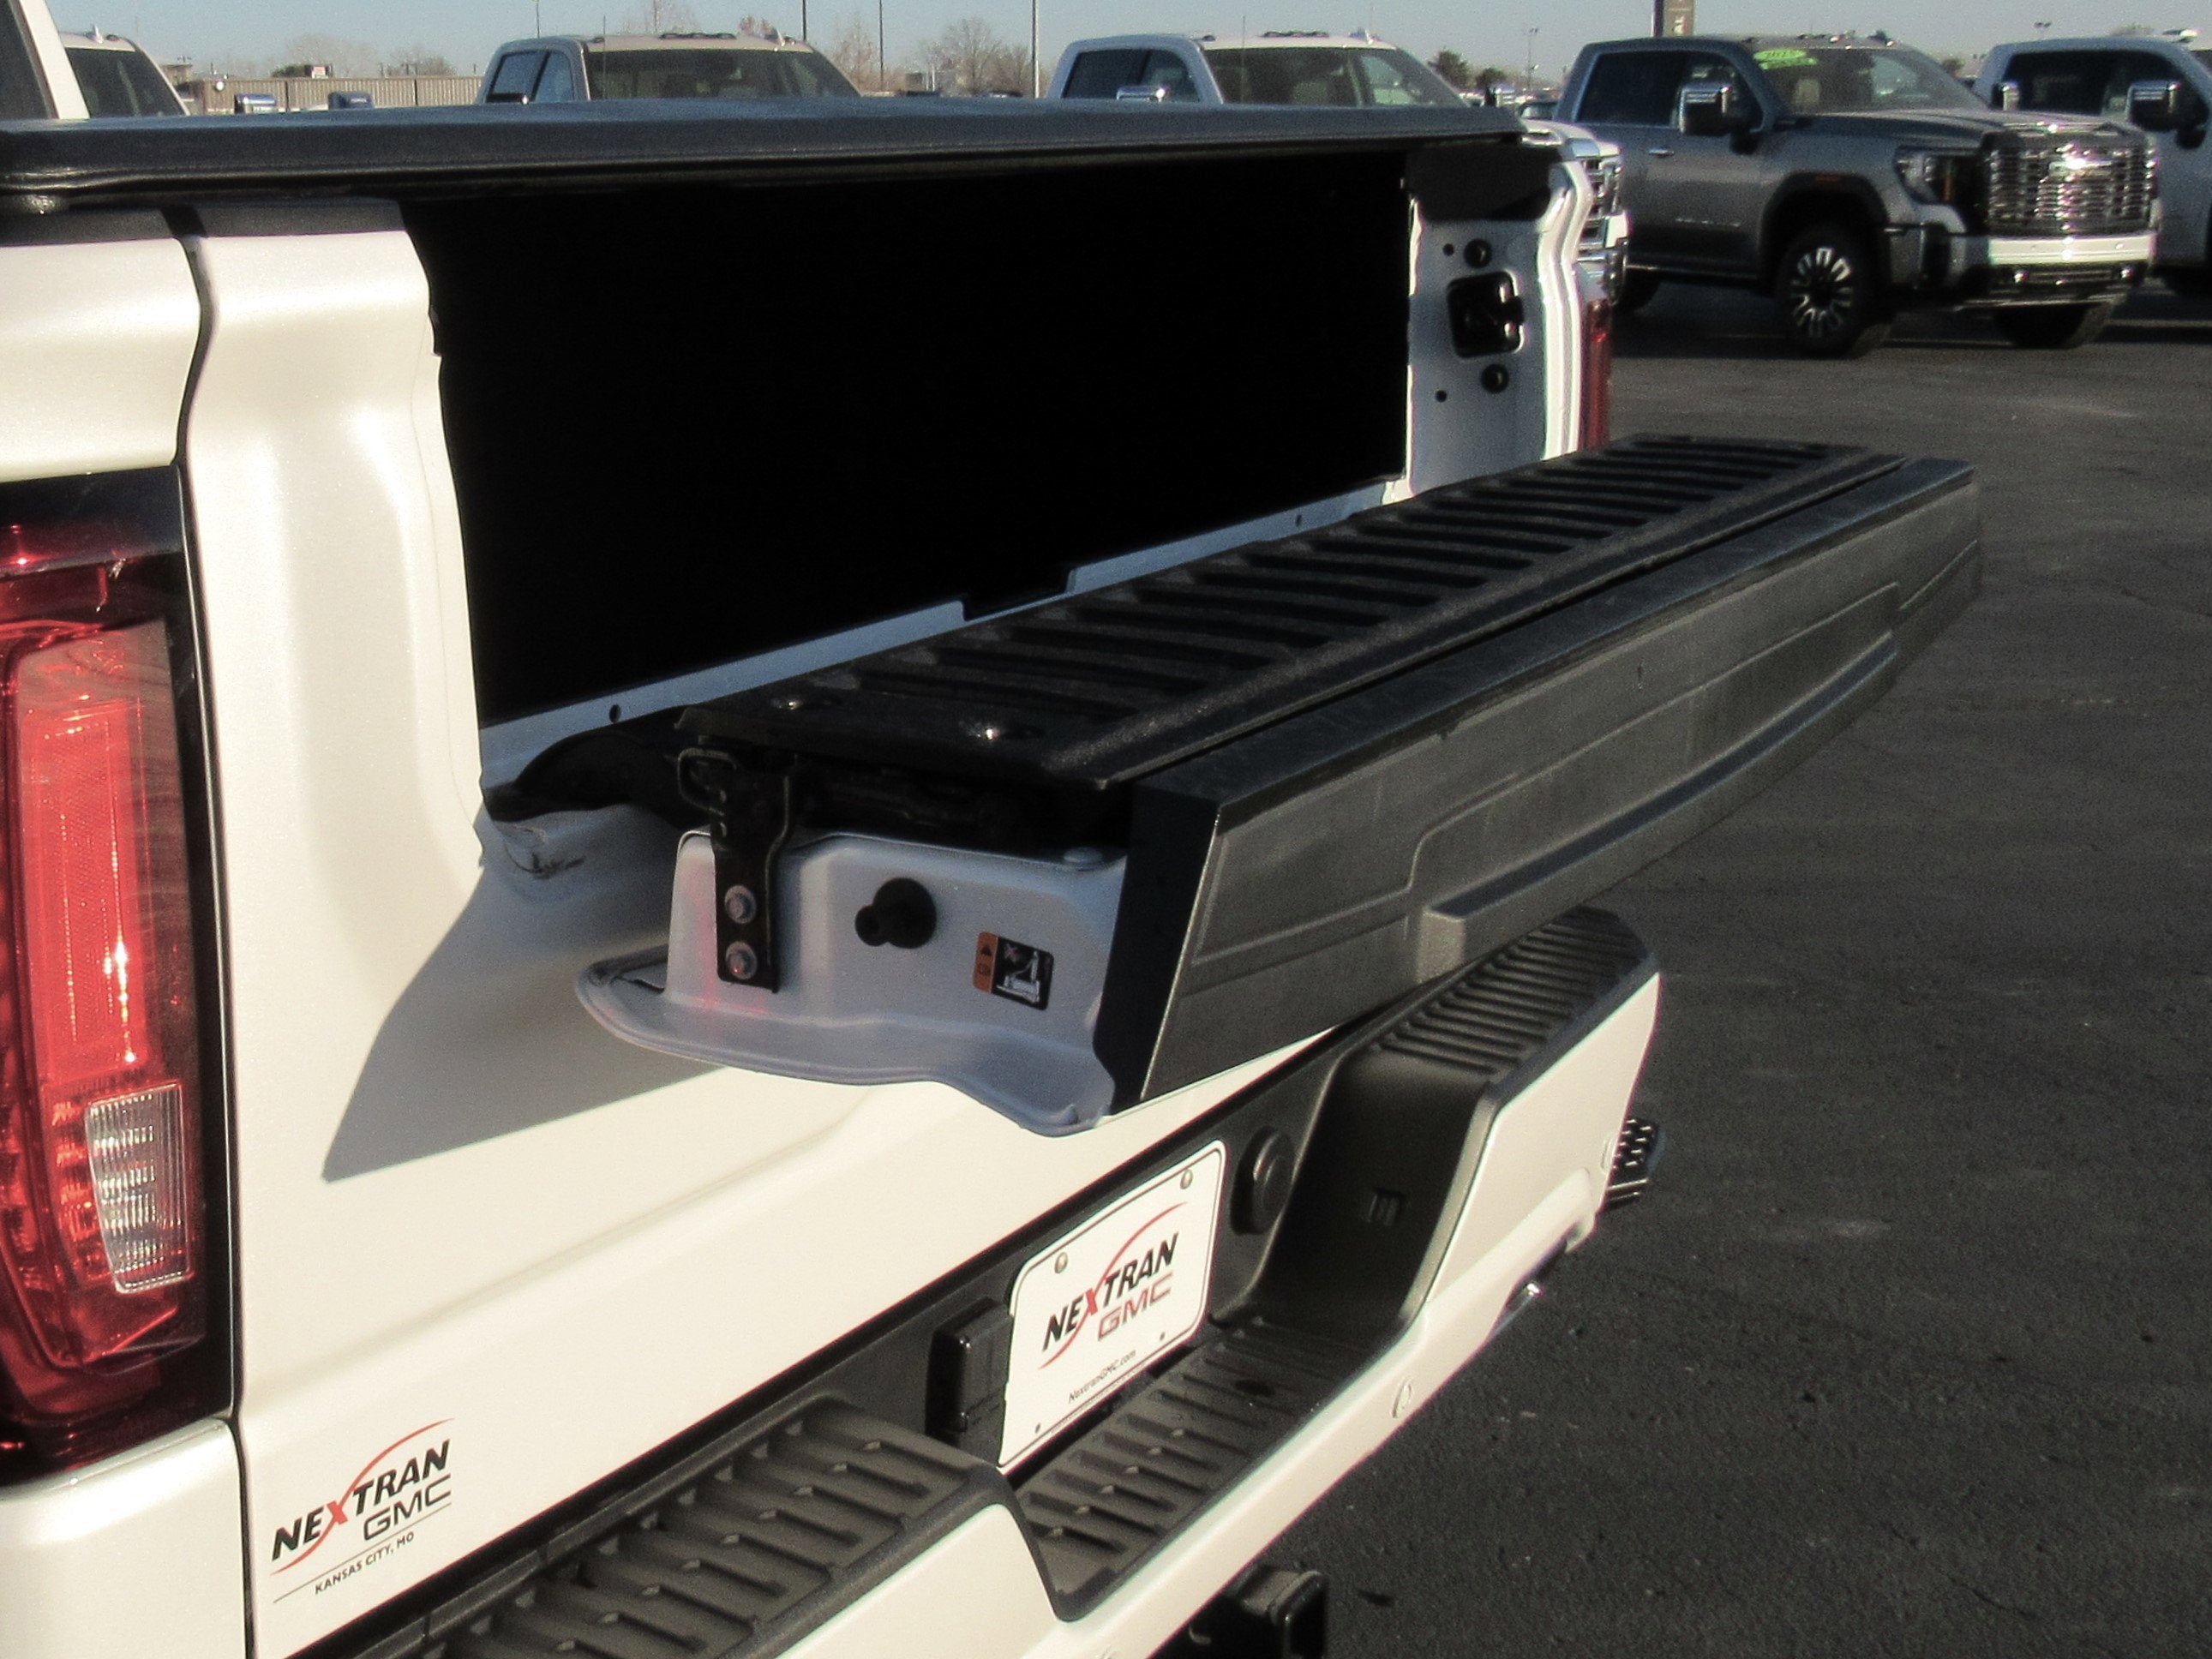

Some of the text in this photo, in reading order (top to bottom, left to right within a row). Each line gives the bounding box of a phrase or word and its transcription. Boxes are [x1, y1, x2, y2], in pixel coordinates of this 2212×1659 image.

[1042, 1231, 1179, 1352] NEXTRAN
[1098, 1272, 1173, 1340] GMC
[272, 1439, 451, 1561] NEXTRAN
[363, 1473, 452, 1541] GMC
[315, 1531, 415, 1595] KANSAS CITY, MO
